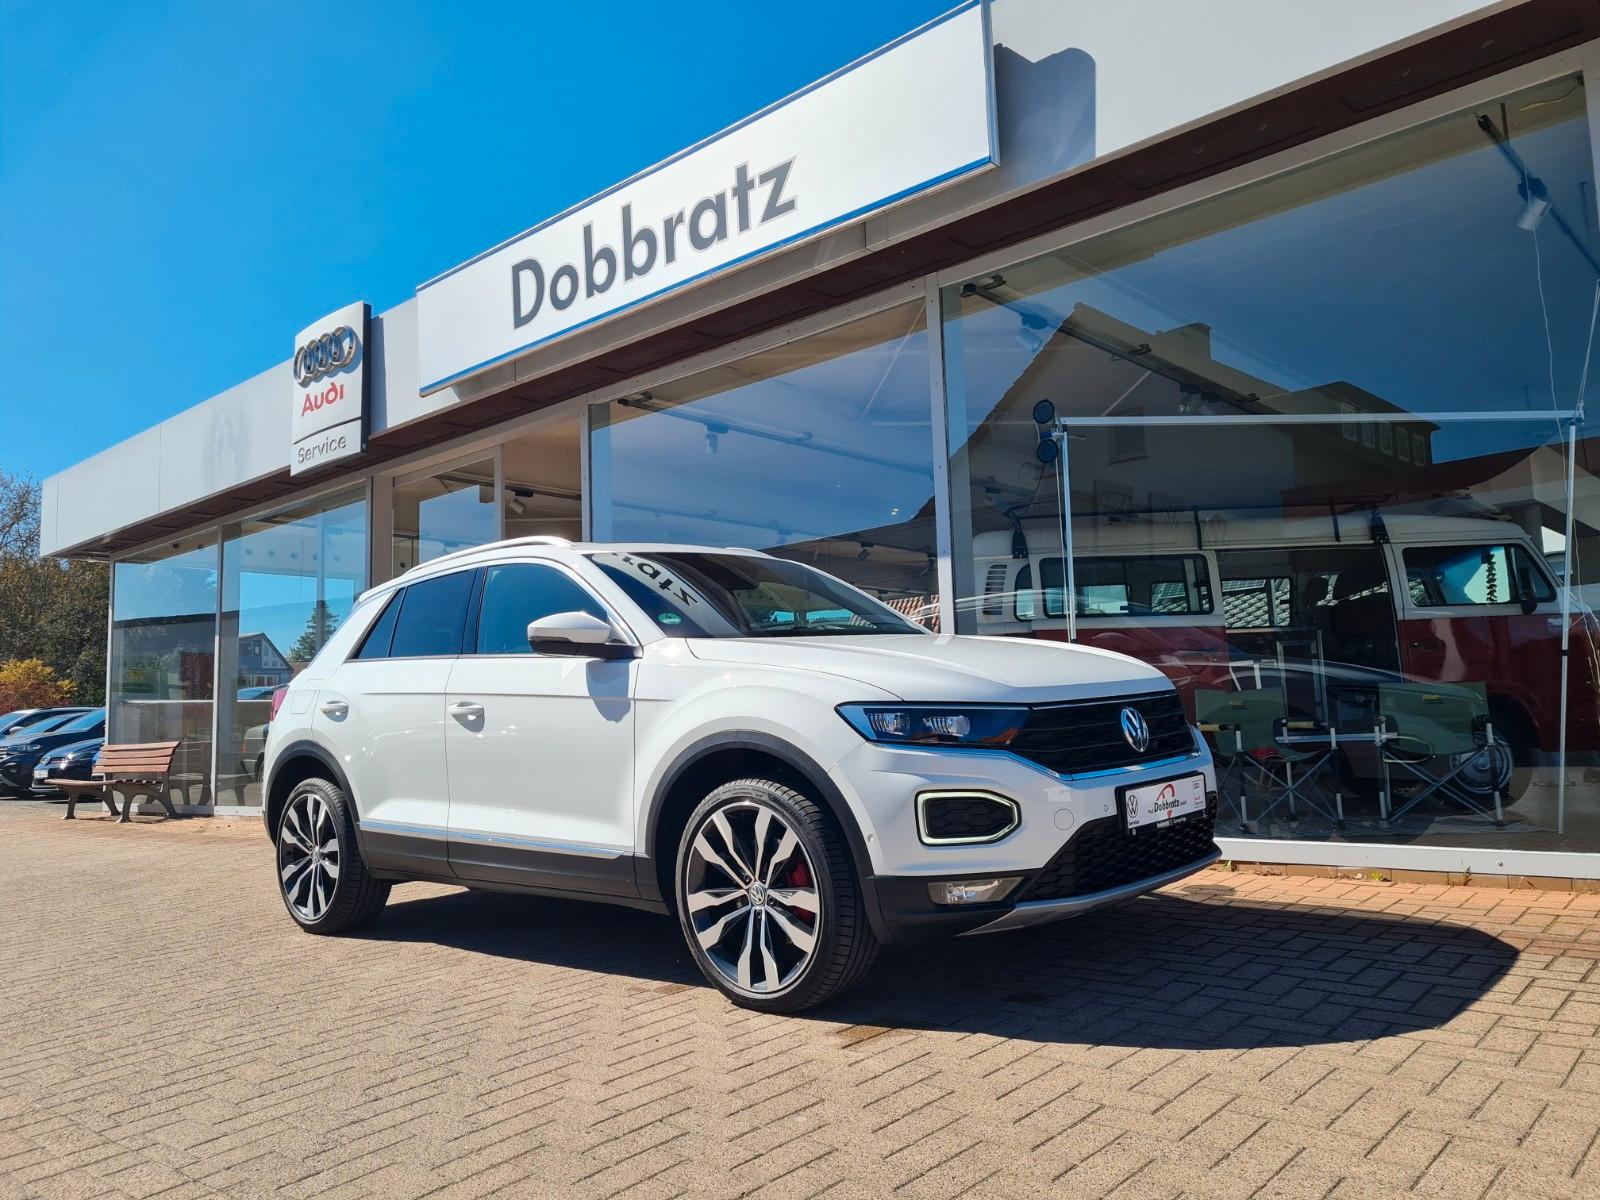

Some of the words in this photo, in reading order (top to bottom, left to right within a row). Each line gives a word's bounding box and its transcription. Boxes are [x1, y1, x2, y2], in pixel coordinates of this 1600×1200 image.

[512, 156, 798, 330] Dobbratz
[301, 381, 345, 417] Audi
[298, 435, 347, 464] Service
[1154, 799, 1179, 812] Dobbratz
